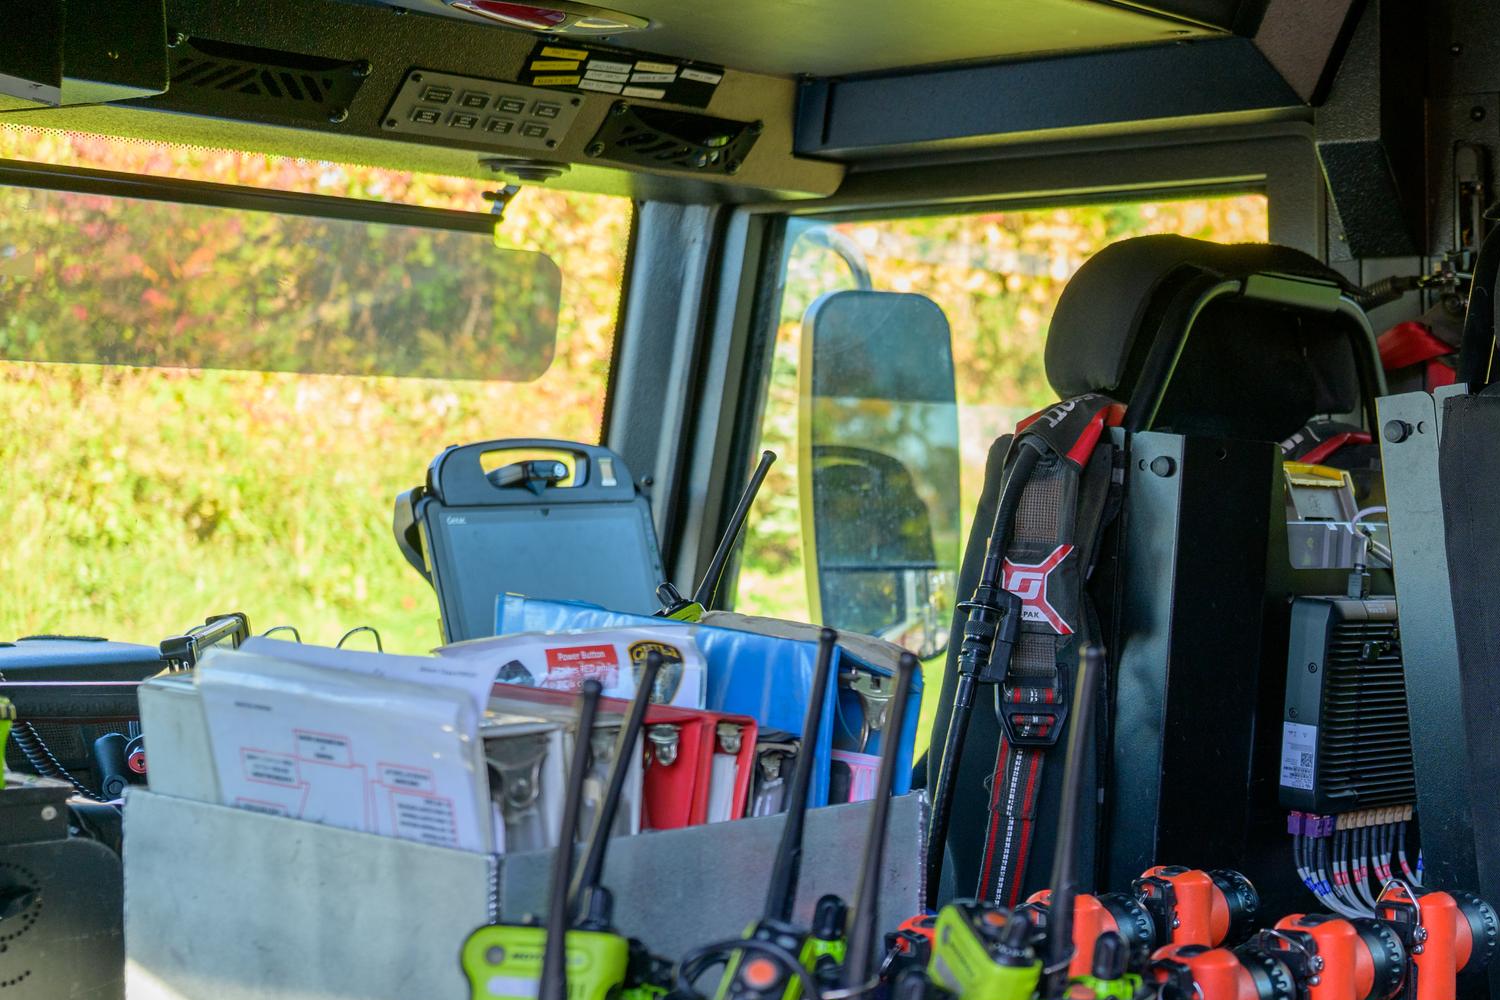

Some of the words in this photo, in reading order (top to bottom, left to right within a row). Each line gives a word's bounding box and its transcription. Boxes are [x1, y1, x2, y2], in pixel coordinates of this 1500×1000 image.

[1023, 611, 1039, 619] PAK
[557, 652, 580, 661] Power
[581, 650, 606, 660] Button
